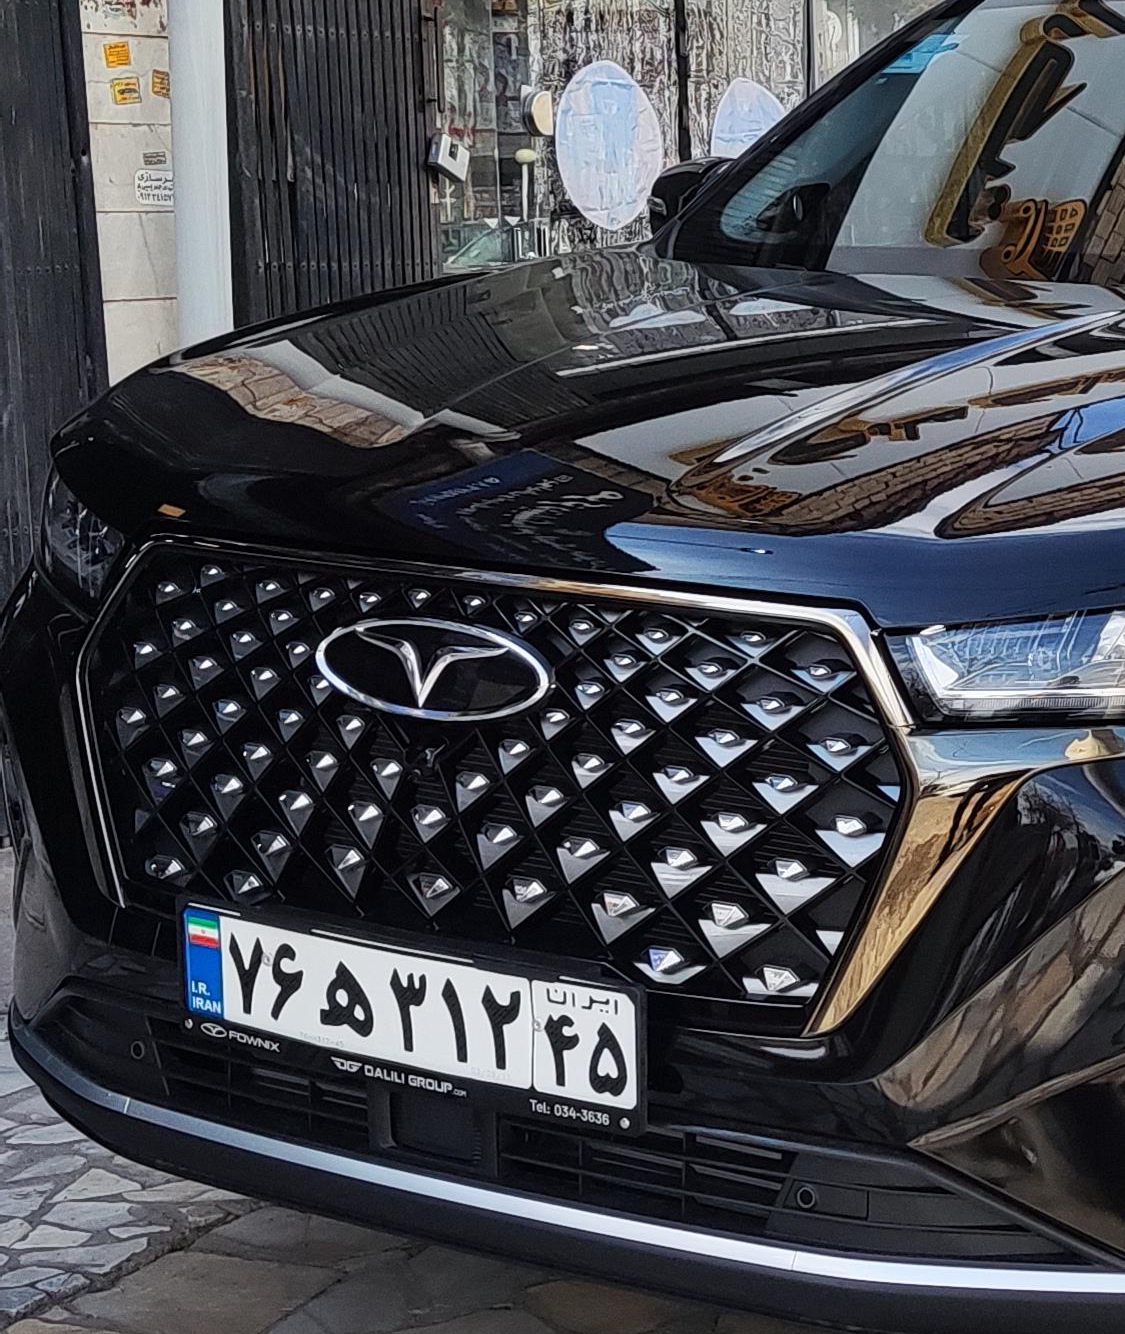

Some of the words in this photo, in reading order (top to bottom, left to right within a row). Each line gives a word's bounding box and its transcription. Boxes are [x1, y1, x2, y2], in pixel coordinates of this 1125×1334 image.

[191, 980, 211, 997] I.R.
[191, 996, 222, 1015] IRAN
[546, 987, 618, 1015] ایران
[228, 1029, 281, 1053] FOWNIX
[543, 1013, 628, 1097] ۴۵
[363, 1064, 406, 1085] DALILI
[528, 1098, 551, 1115] Tel:
[553, 1104, 610, 1126] 034-3636
